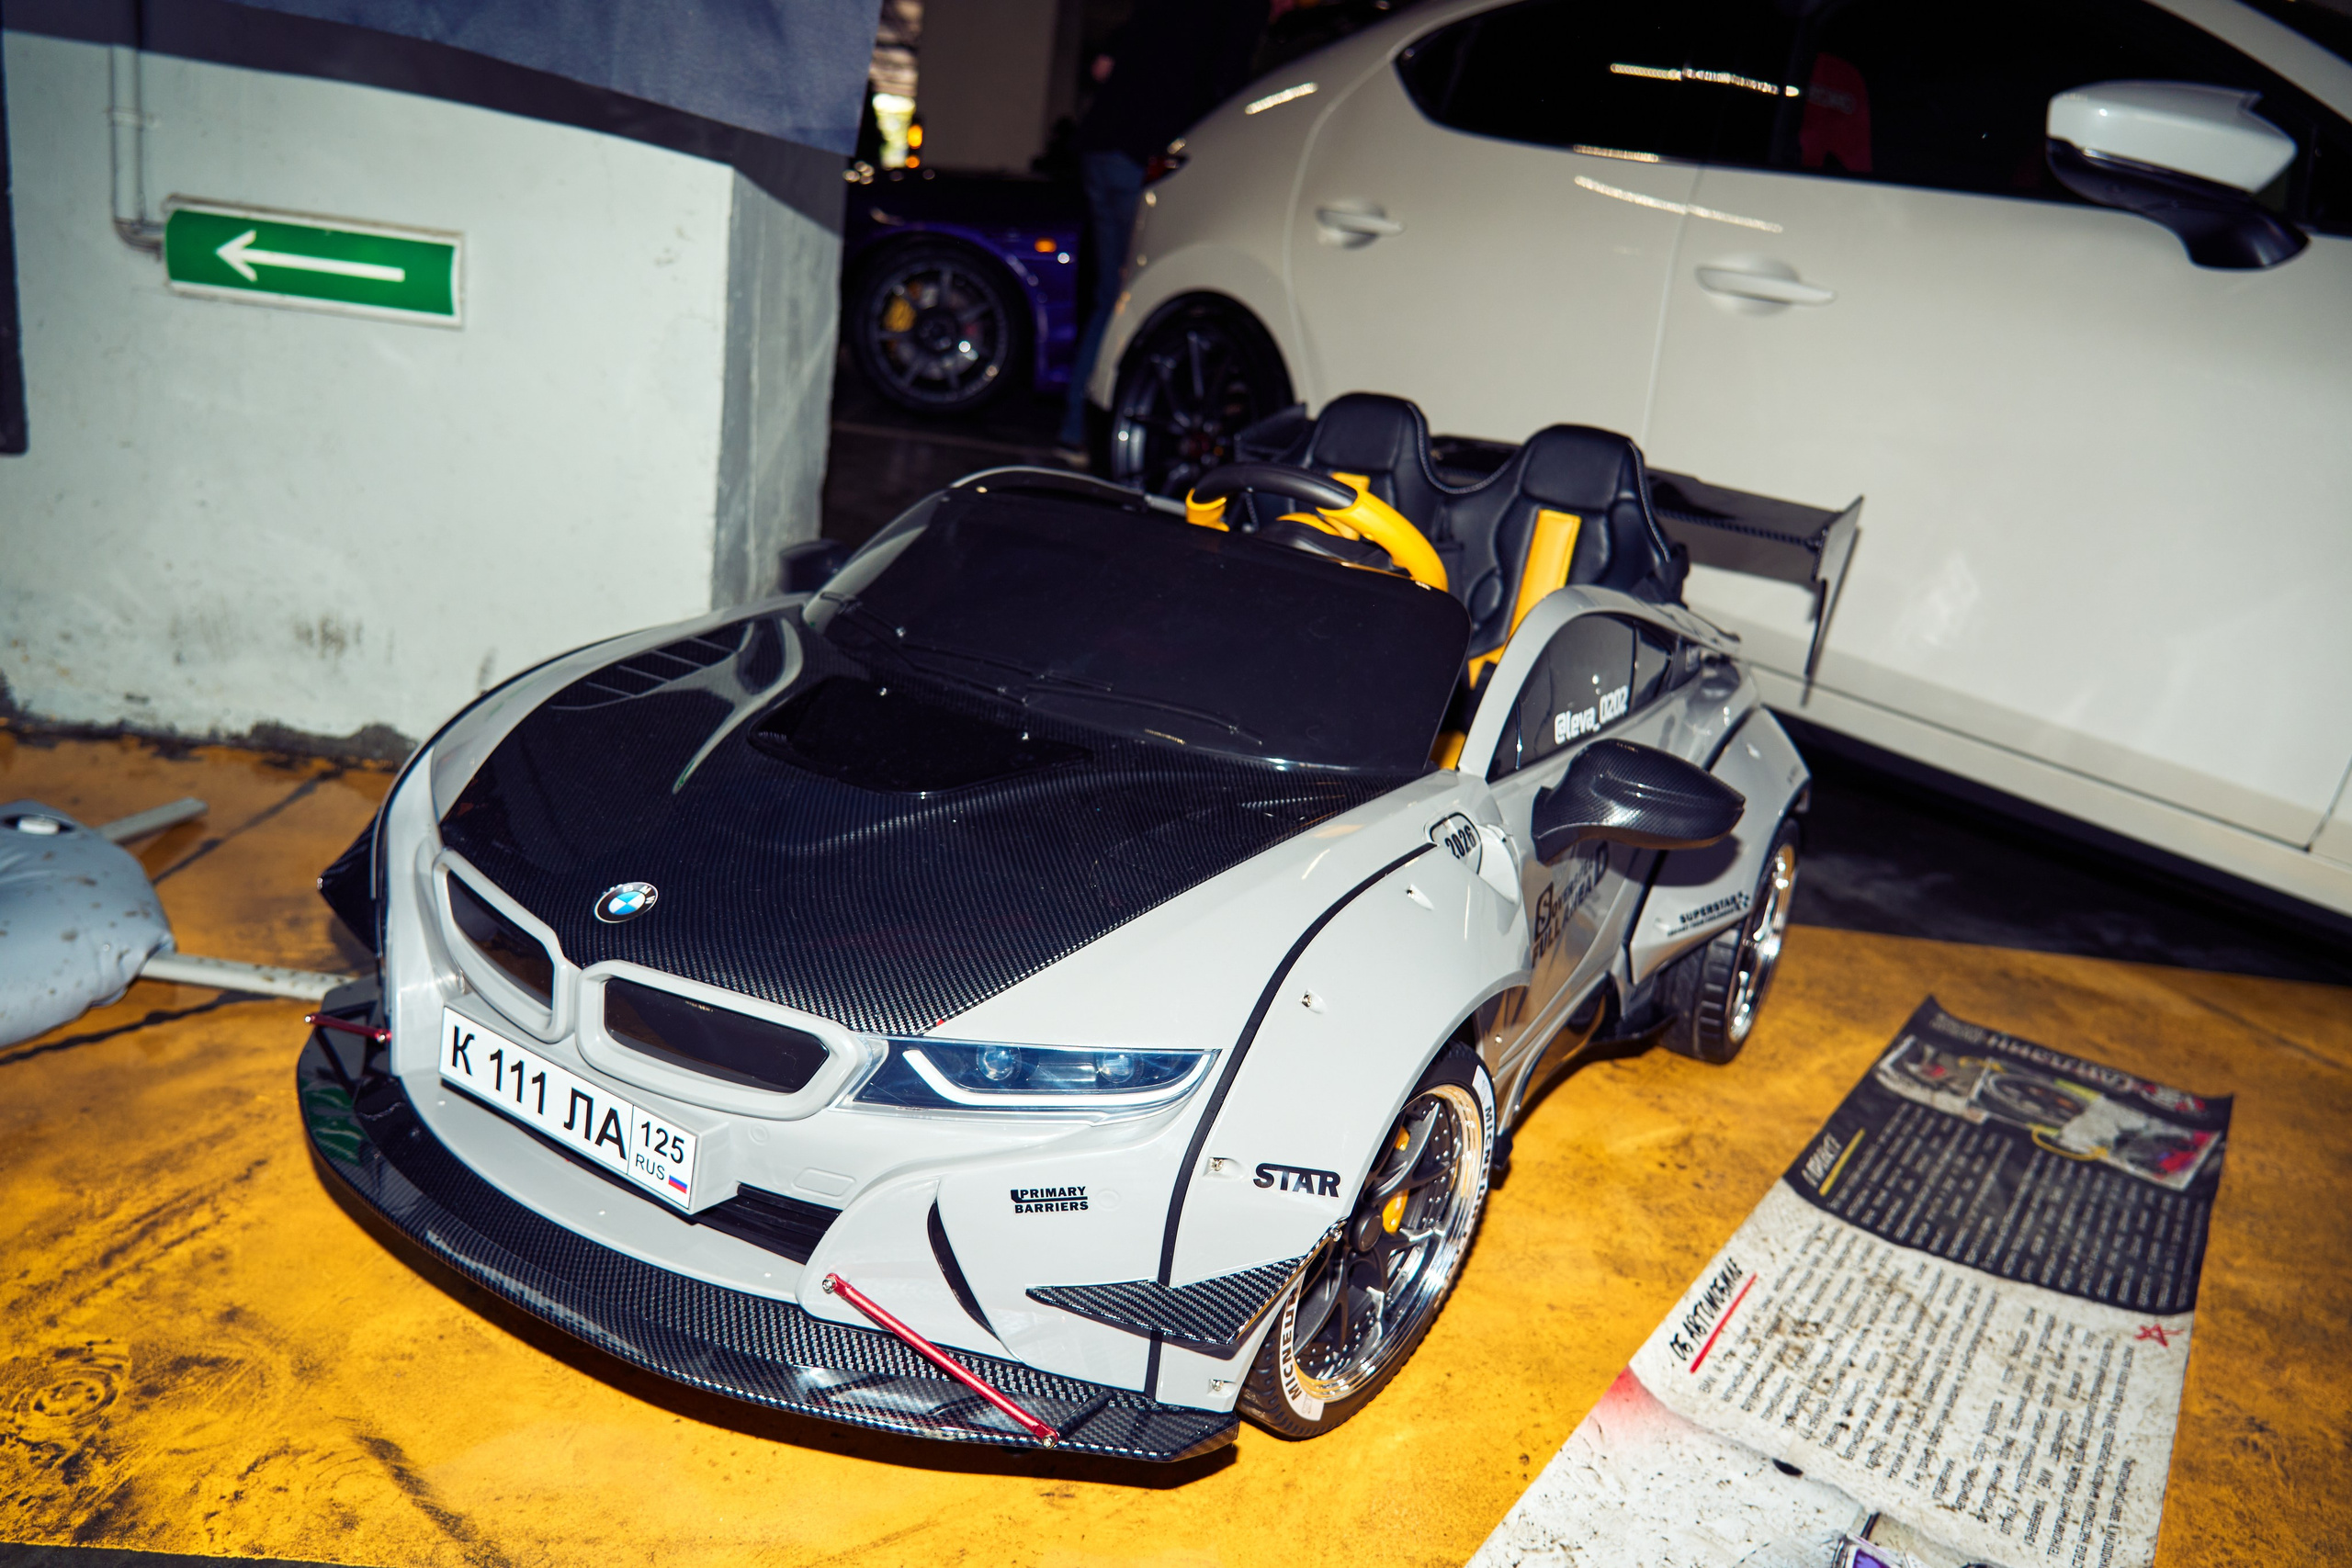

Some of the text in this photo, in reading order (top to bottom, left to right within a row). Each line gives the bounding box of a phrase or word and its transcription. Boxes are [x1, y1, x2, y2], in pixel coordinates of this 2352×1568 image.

[1555, 685, 1629, 745] @leva_0202
[1444, 825, 1476, 860] 2026
[451, 1025, 627, 1161] К 111 ЛА
[641, 1121, 684, 1164] 125
[635, 1153, 665, 1181] RUS
[1253, 1163, 1341, 1198] STAR
[1015, 1201, 1089, 1213] BARRIERS
[1020, 1186, 1086, 1199] PRIMARY
[1670, 1257, 1743, 1361] ОБ АВТОМОБИЛЕ
